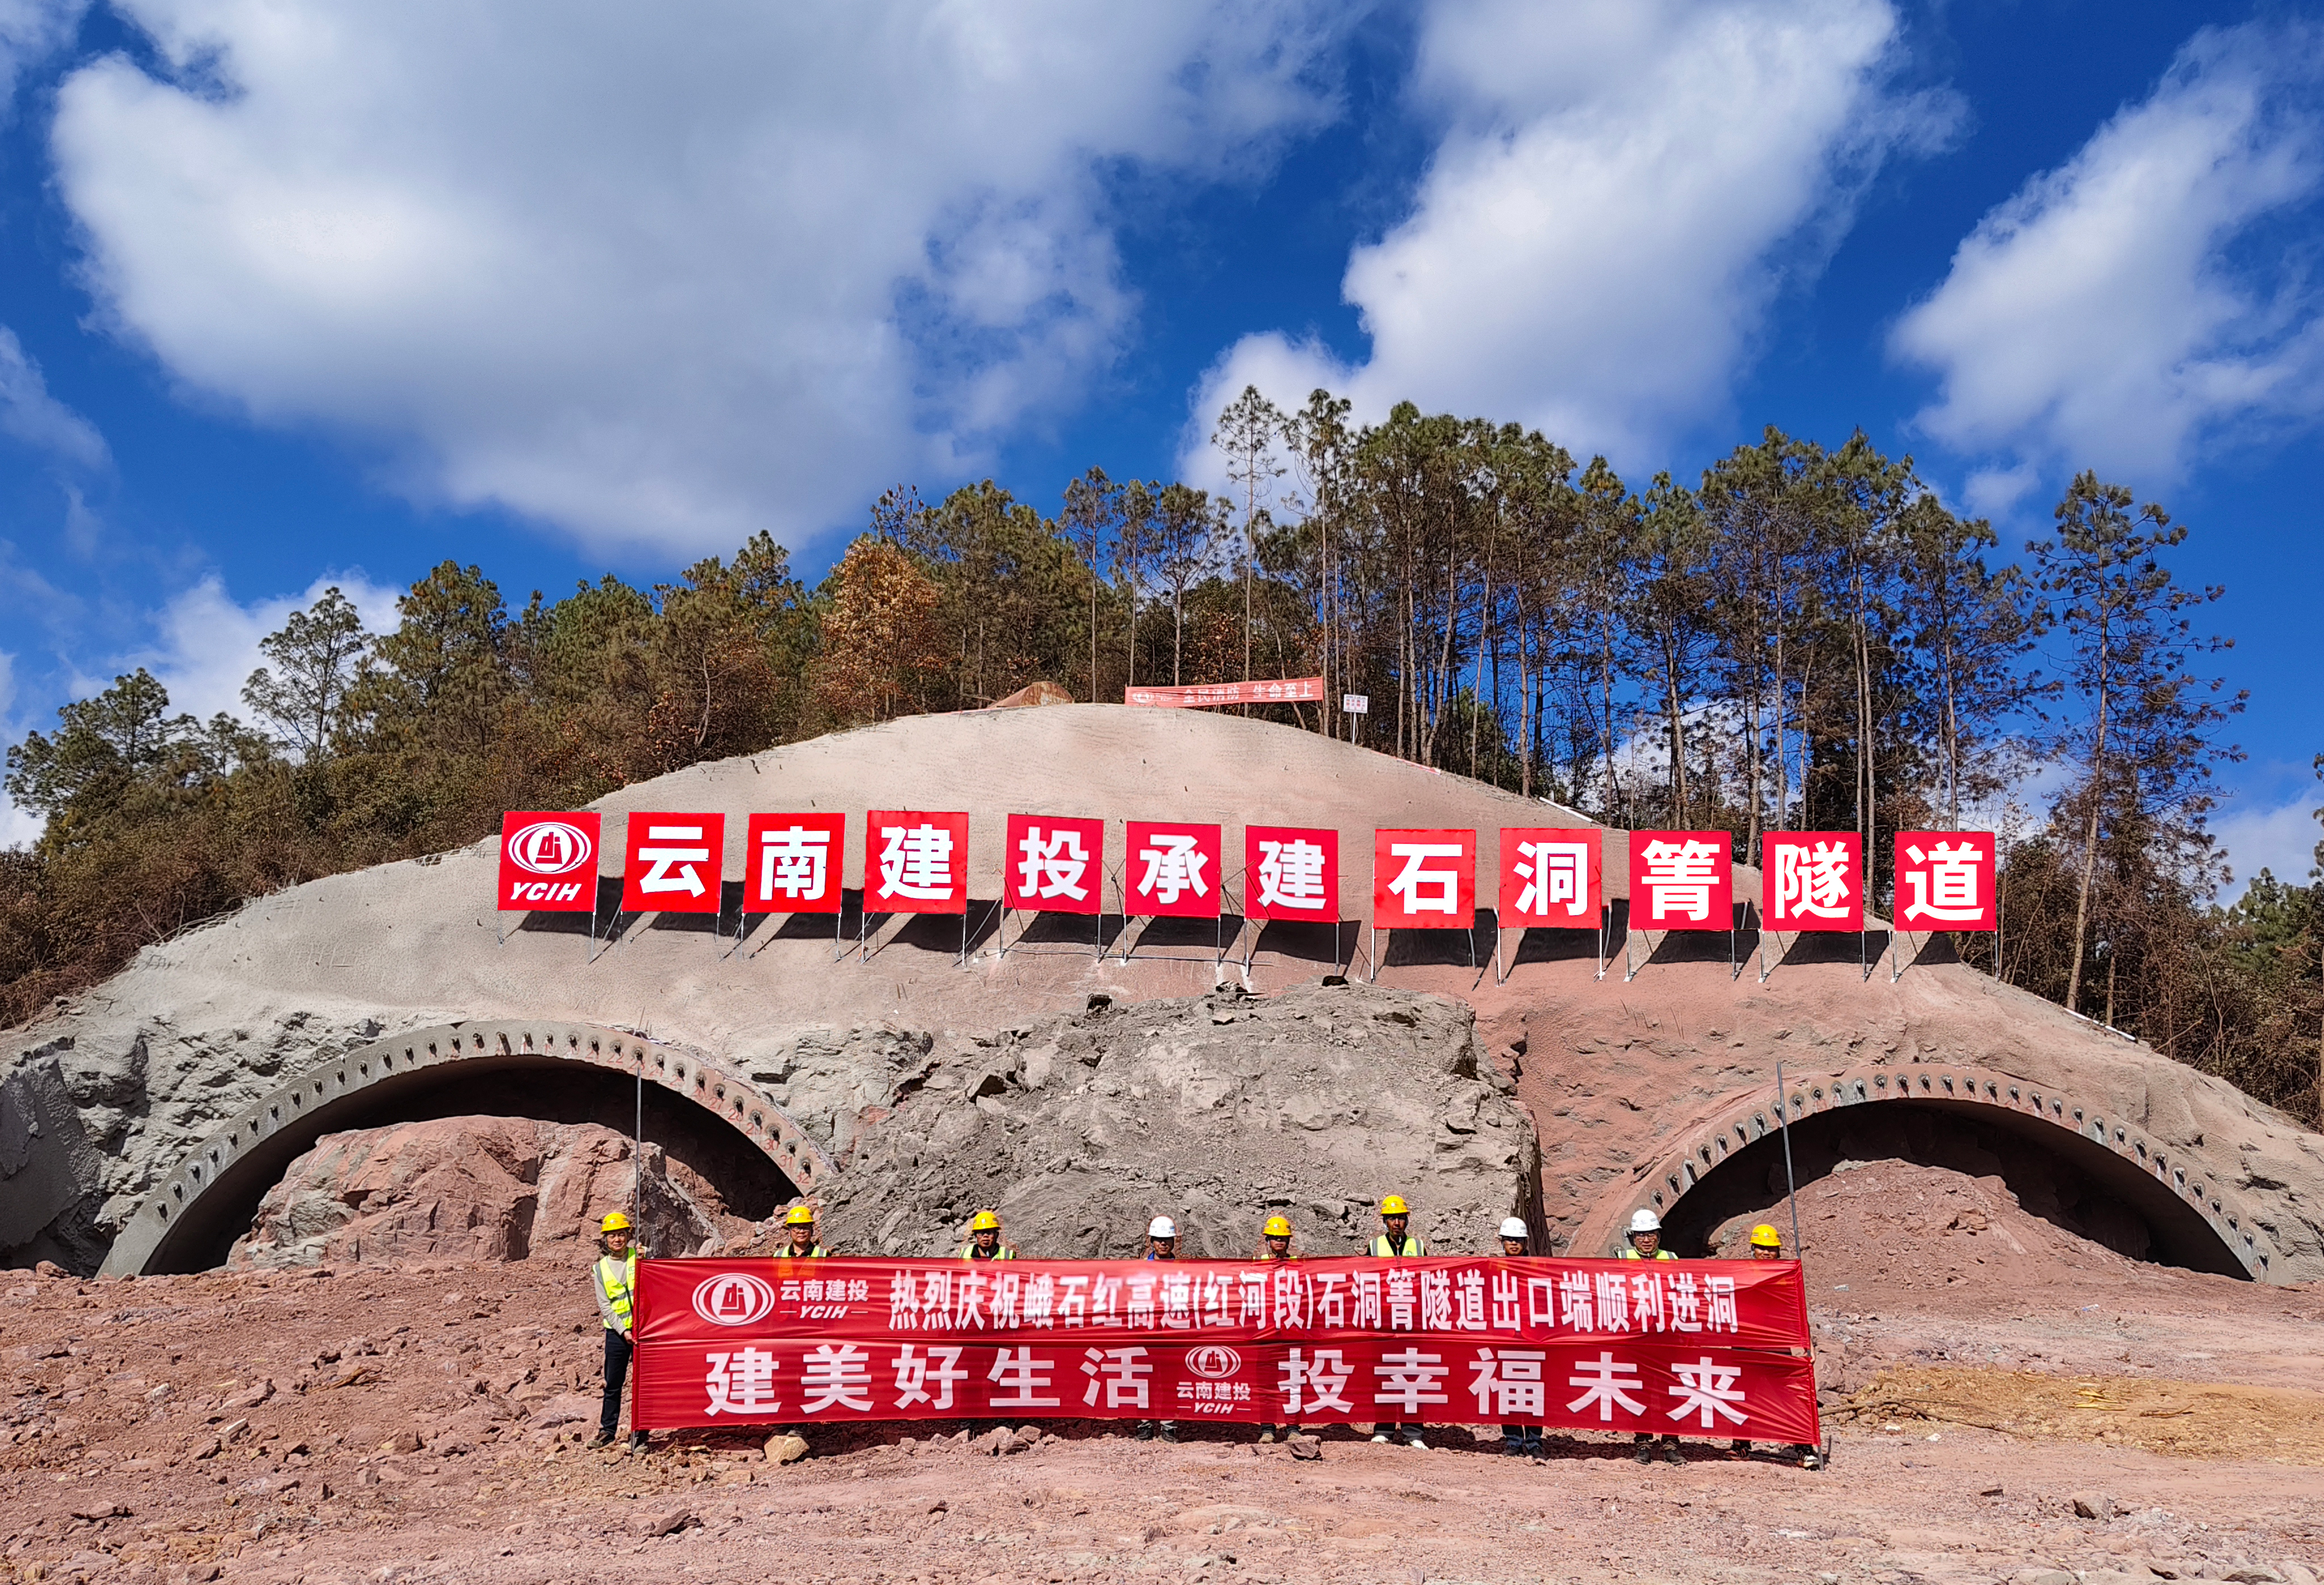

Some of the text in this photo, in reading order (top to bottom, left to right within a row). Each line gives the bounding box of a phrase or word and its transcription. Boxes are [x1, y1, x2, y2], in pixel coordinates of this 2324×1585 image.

[1183, 685, 1240, 703] 全民消防
[1253, 681, 1314, 699] 生命至上
[639, 824, 1984, 921] 云南建投承建石洞箐隧道
[511, 882, 582, 901] YCIH
[780, 1279, 869, 1302] 云南建投
[799, 1305, 848, 1319] YCIH
[704, 1343, 1749, 1428] 建美好生活 投幸福未来
[1177, 1381, 1251, 1401] 云南建投
[1193, 1402, 1234, 1414] YCIH
